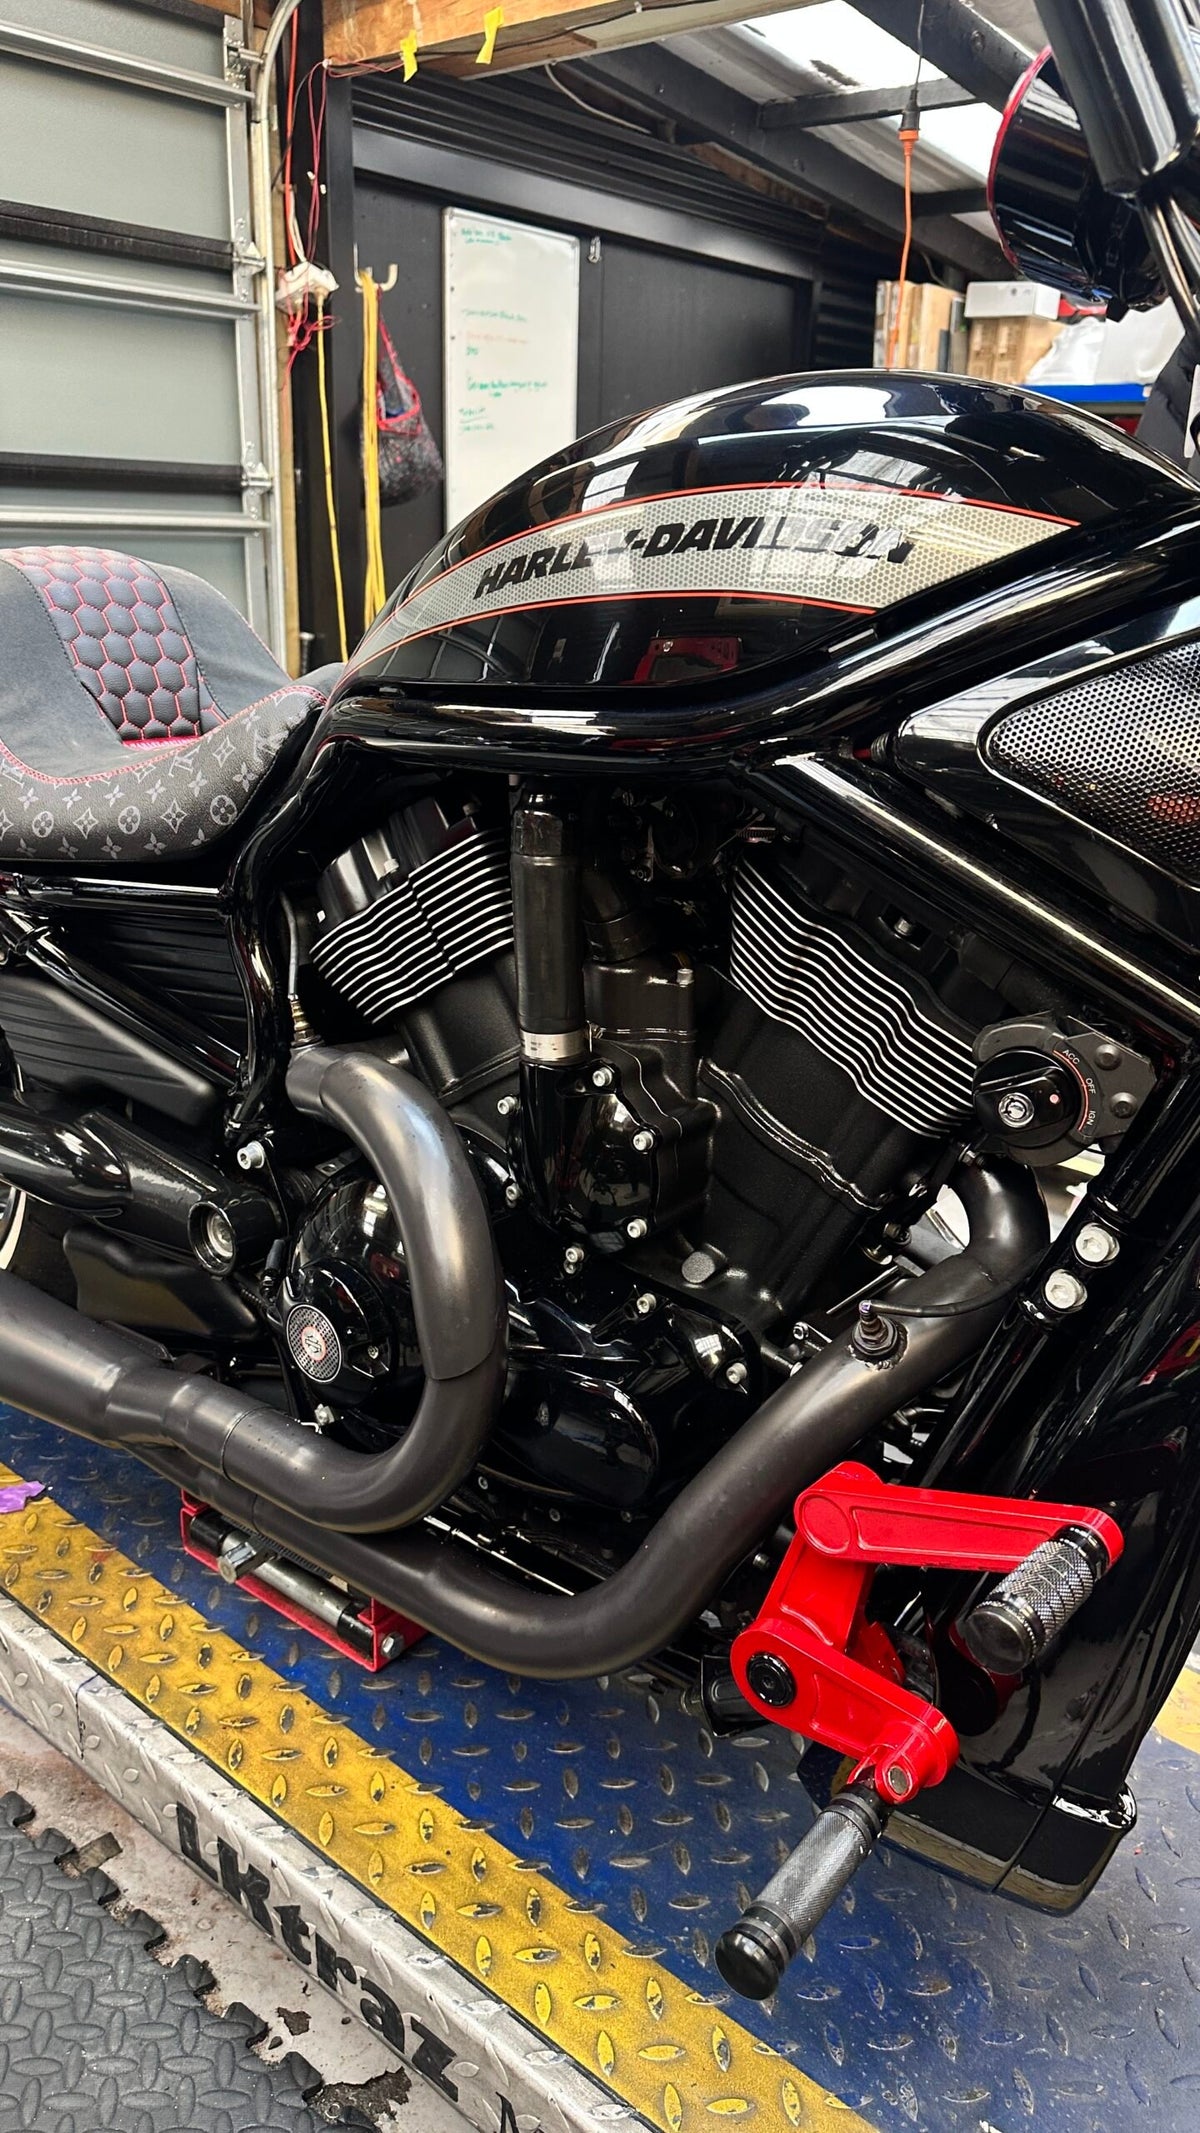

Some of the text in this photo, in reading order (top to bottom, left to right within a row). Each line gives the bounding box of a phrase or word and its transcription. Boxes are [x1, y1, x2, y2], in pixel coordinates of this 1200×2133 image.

[473, 515, 918, 599] HARLEY-DAVIDSON
[1062, 1049, 1080, 1065] ACC
[1085, 1077, 1096, 1095] OFF
[1086, 1110, 1096, 1126] IGN
